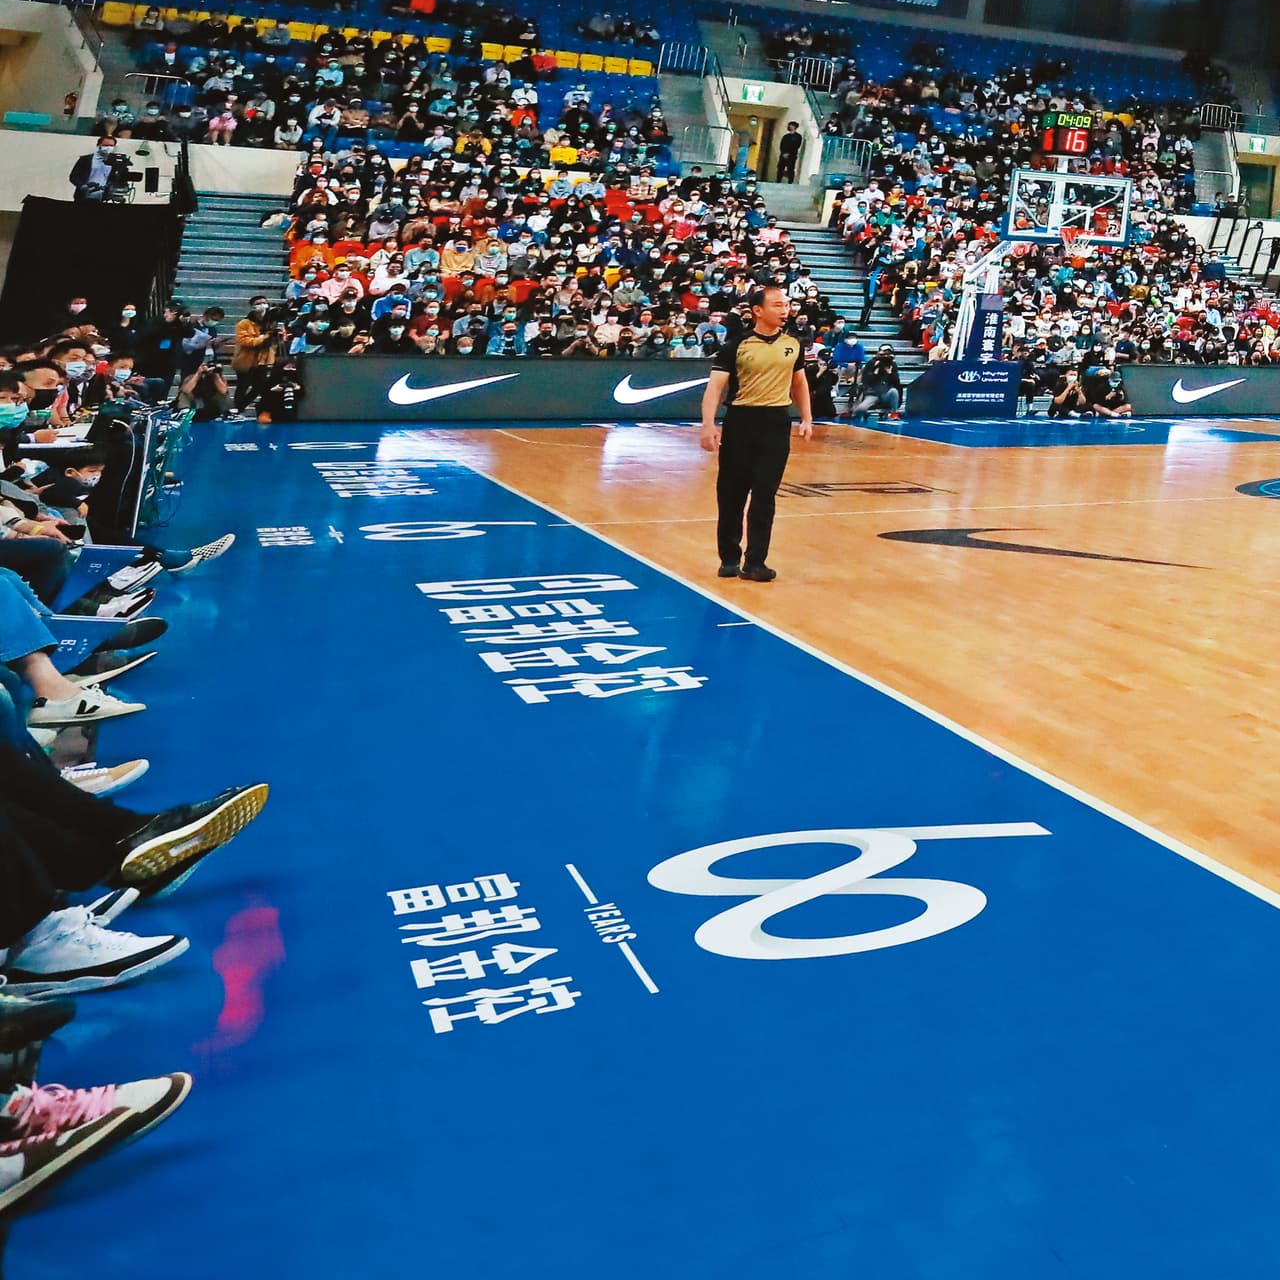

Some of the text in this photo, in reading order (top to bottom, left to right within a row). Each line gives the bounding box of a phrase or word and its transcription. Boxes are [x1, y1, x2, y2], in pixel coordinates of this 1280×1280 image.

[1057, 113, 1092, 128] 04:09
[1063, 130, 1088, 152] 16
[439, 598, 710, 704] 富邦金控
[583, 901, 638, 945] YEARS
[386, 873, 582, 1034] 富邦金控
